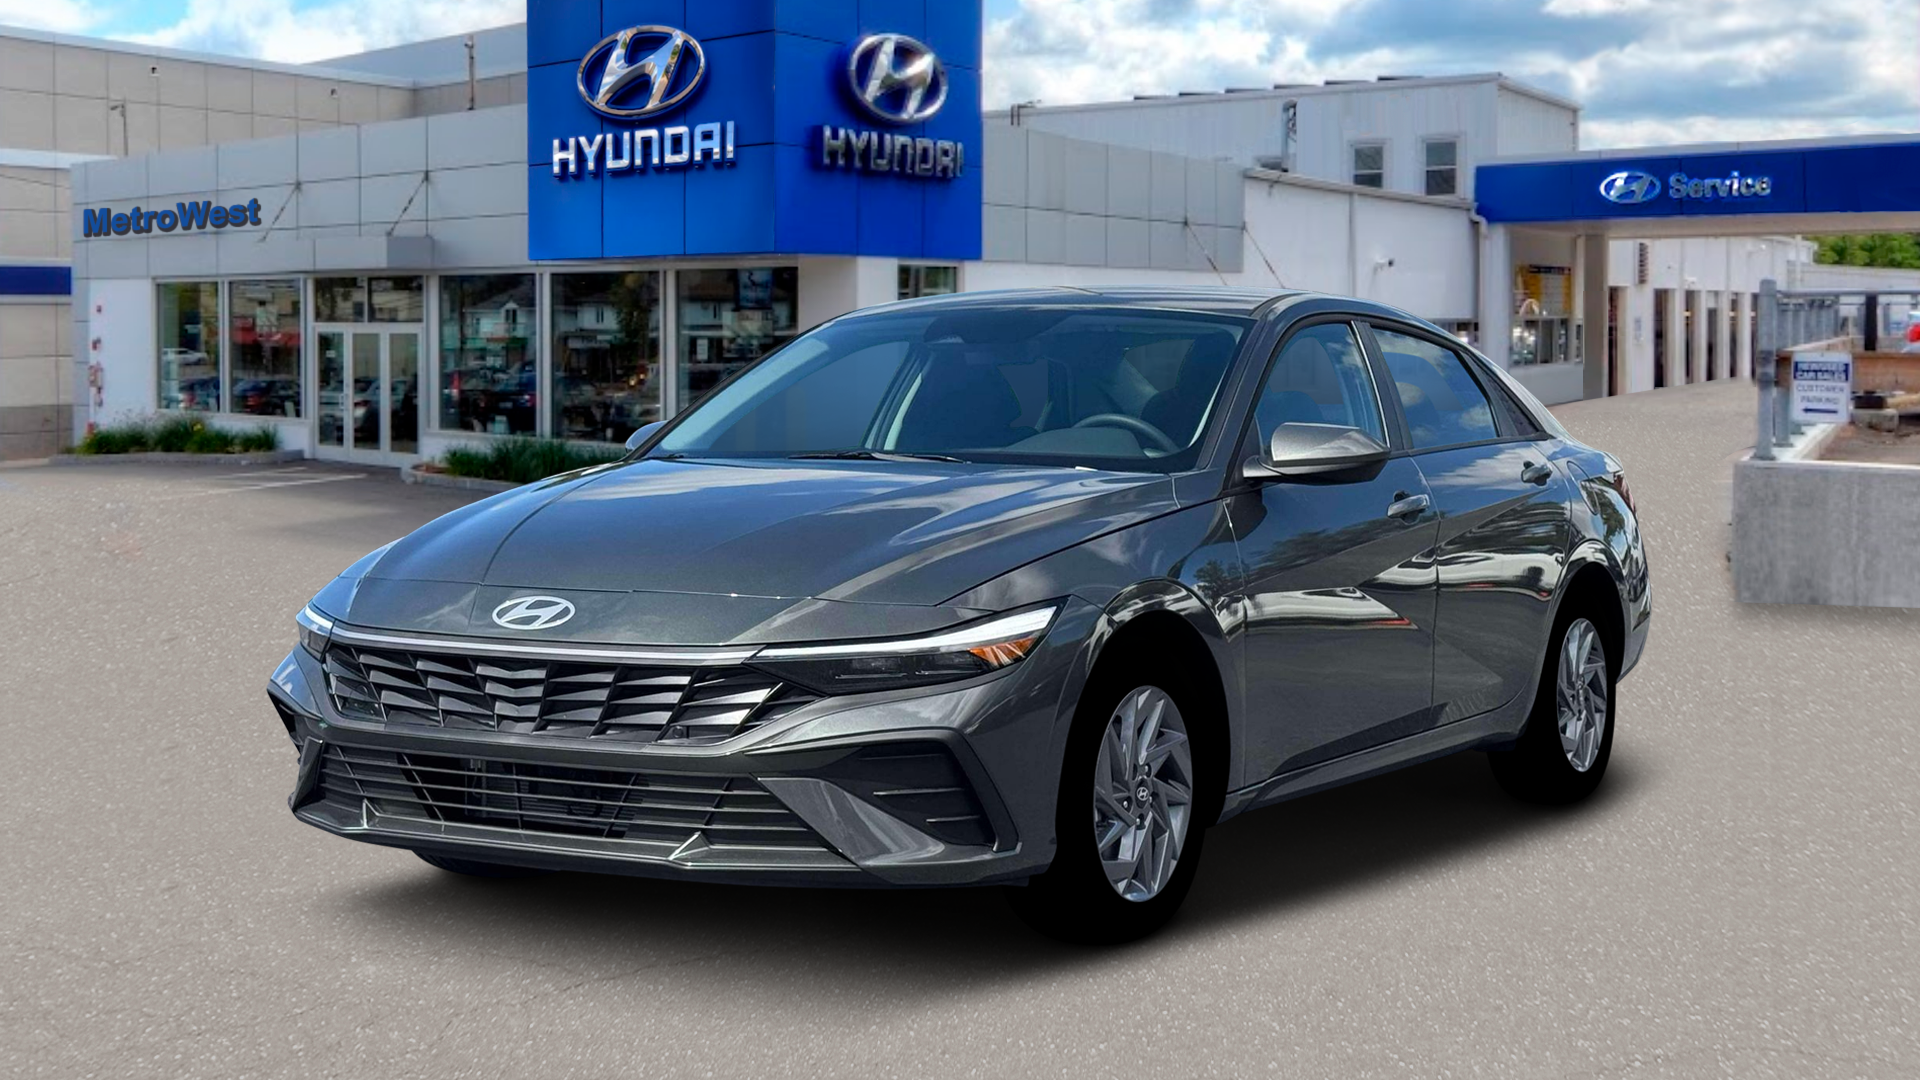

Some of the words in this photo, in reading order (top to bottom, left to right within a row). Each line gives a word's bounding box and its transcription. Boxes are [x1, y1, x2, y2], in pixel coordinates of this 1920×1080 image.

[552, 120, 736, 179] HYUNDAI
[821, 124, 965, 179] HYUNDAI
[1668, 171, 1772, 199] Service
[83, 198, 262, 238] MetroWest
